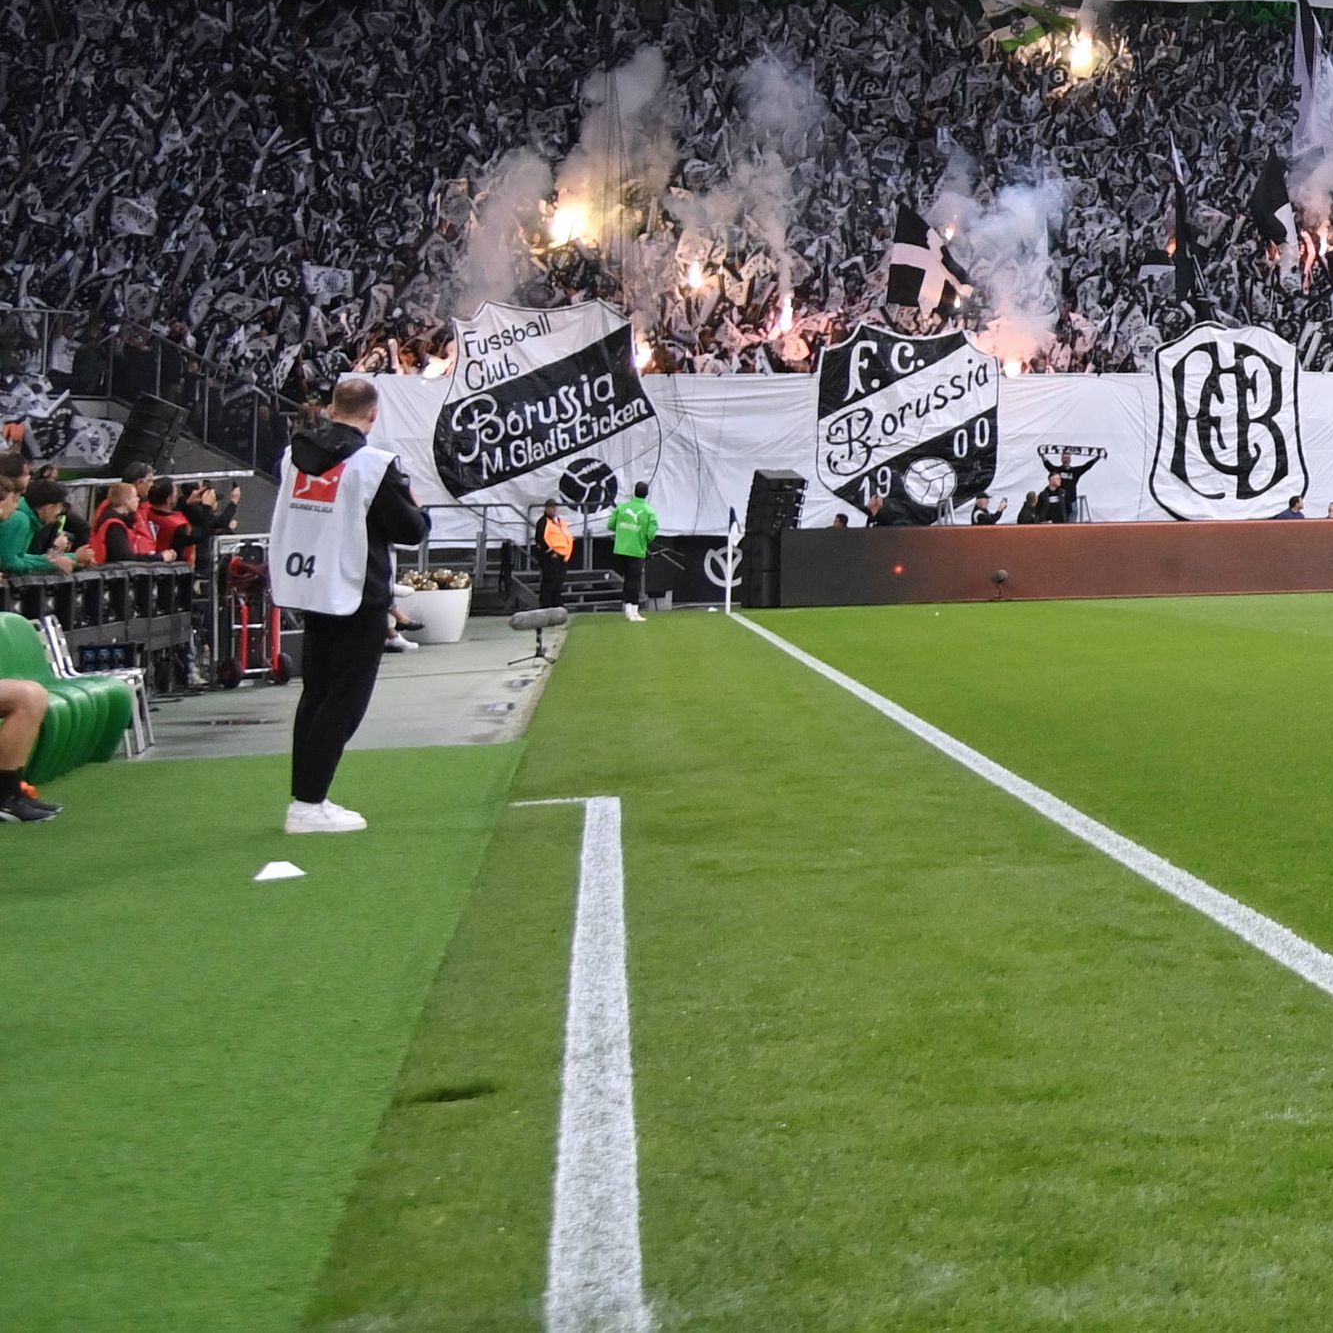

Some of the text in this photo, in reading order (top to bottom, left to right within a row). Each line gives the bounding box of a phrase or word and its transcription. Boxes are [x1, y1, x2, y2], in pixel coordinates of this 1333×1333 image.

[463, 313, 552, 358] Fussball
[464, 354, 520, 391] Club
[452, 372, 616, 464] Borussia
[826, 359, 990, 477] Borussia
[285, 551, 318, 580] 04
